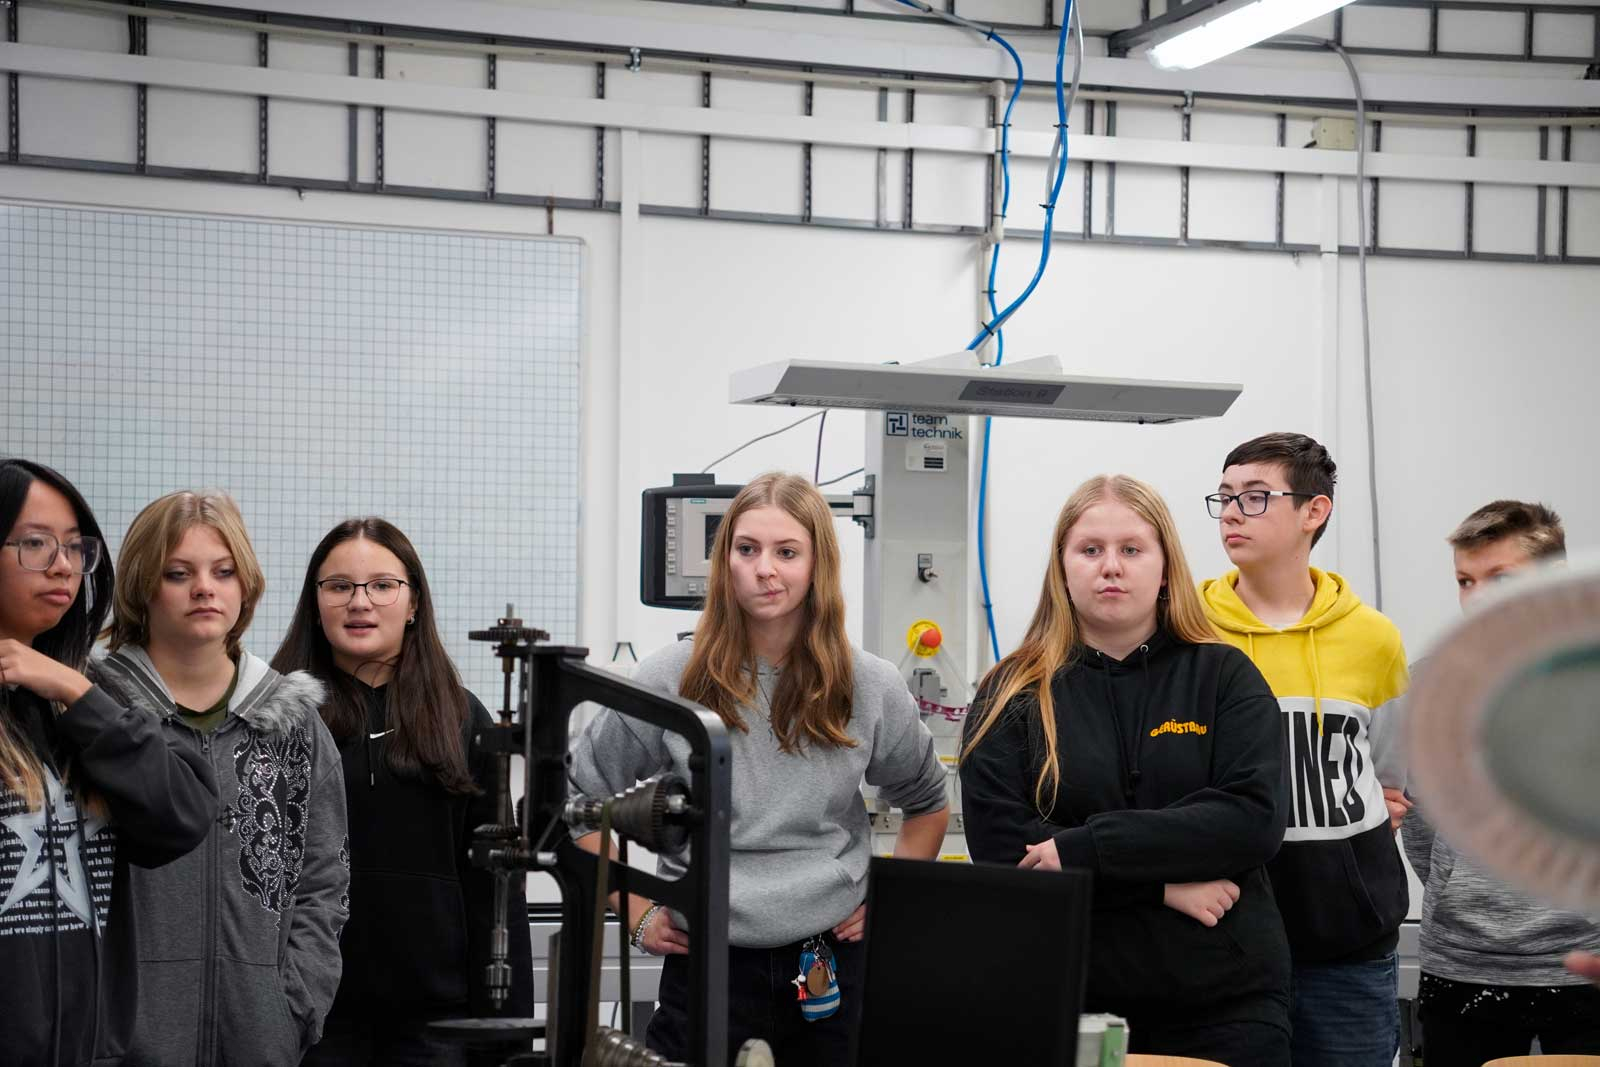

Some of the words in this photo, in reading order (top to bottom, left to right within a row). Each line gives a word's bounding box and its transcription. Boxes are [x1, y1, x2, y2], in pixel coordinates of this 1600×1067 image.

[912, 414, 948, 425] team
[912, 427, 963, 439] technik
[1150, 719, 1207, 737] GERÜSTBAU
